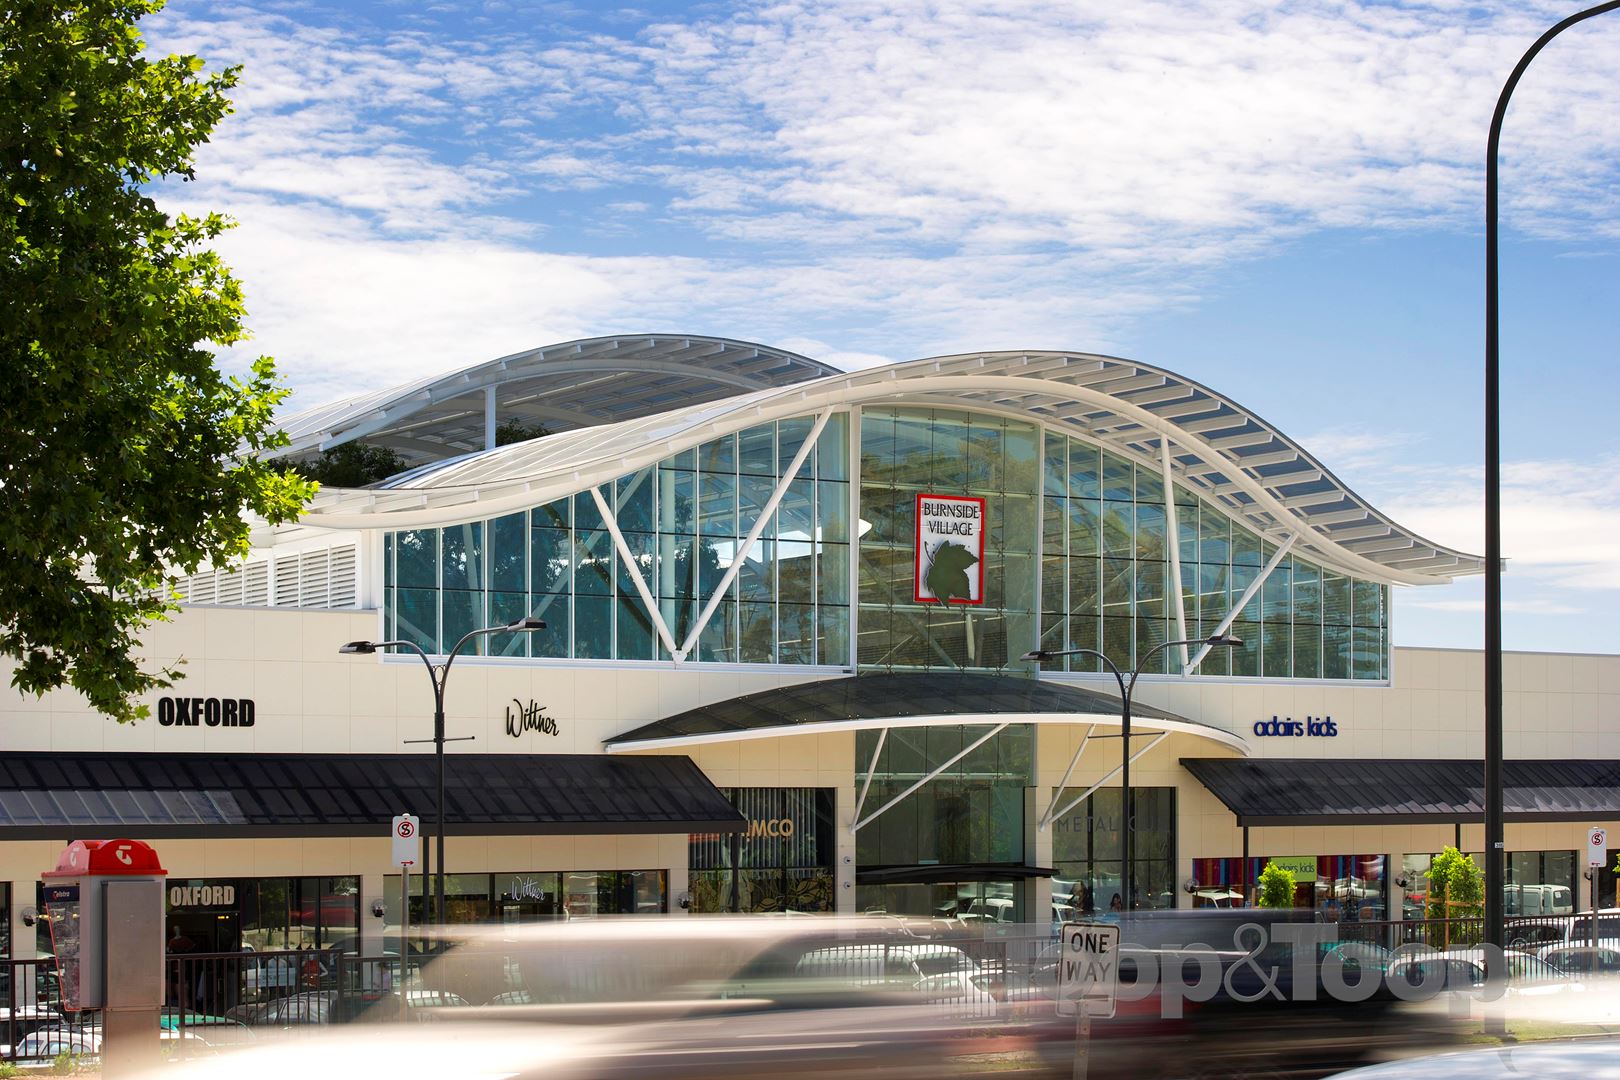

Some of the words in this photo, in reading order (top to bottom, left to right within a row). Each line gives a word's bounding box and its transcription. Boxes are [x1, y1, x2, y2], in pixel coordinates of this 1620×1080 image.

[923, 502, 980, 519] BURNSIDE
[928, 520, 974, 536] VILLAGE
[158, 697, 255, 727] OXFORD
[506, 698, 560, 738] Wittner
[1253, 715, 1304, 737] adairs
[1307, 716, 1338, 737] kids
[170, 886, 235, 906] OXFORD
[511, 875, 546, 901] Wittner
[1071, 932, 1110, 953] ONE
[1066, 960, 1111, 982] WAY
